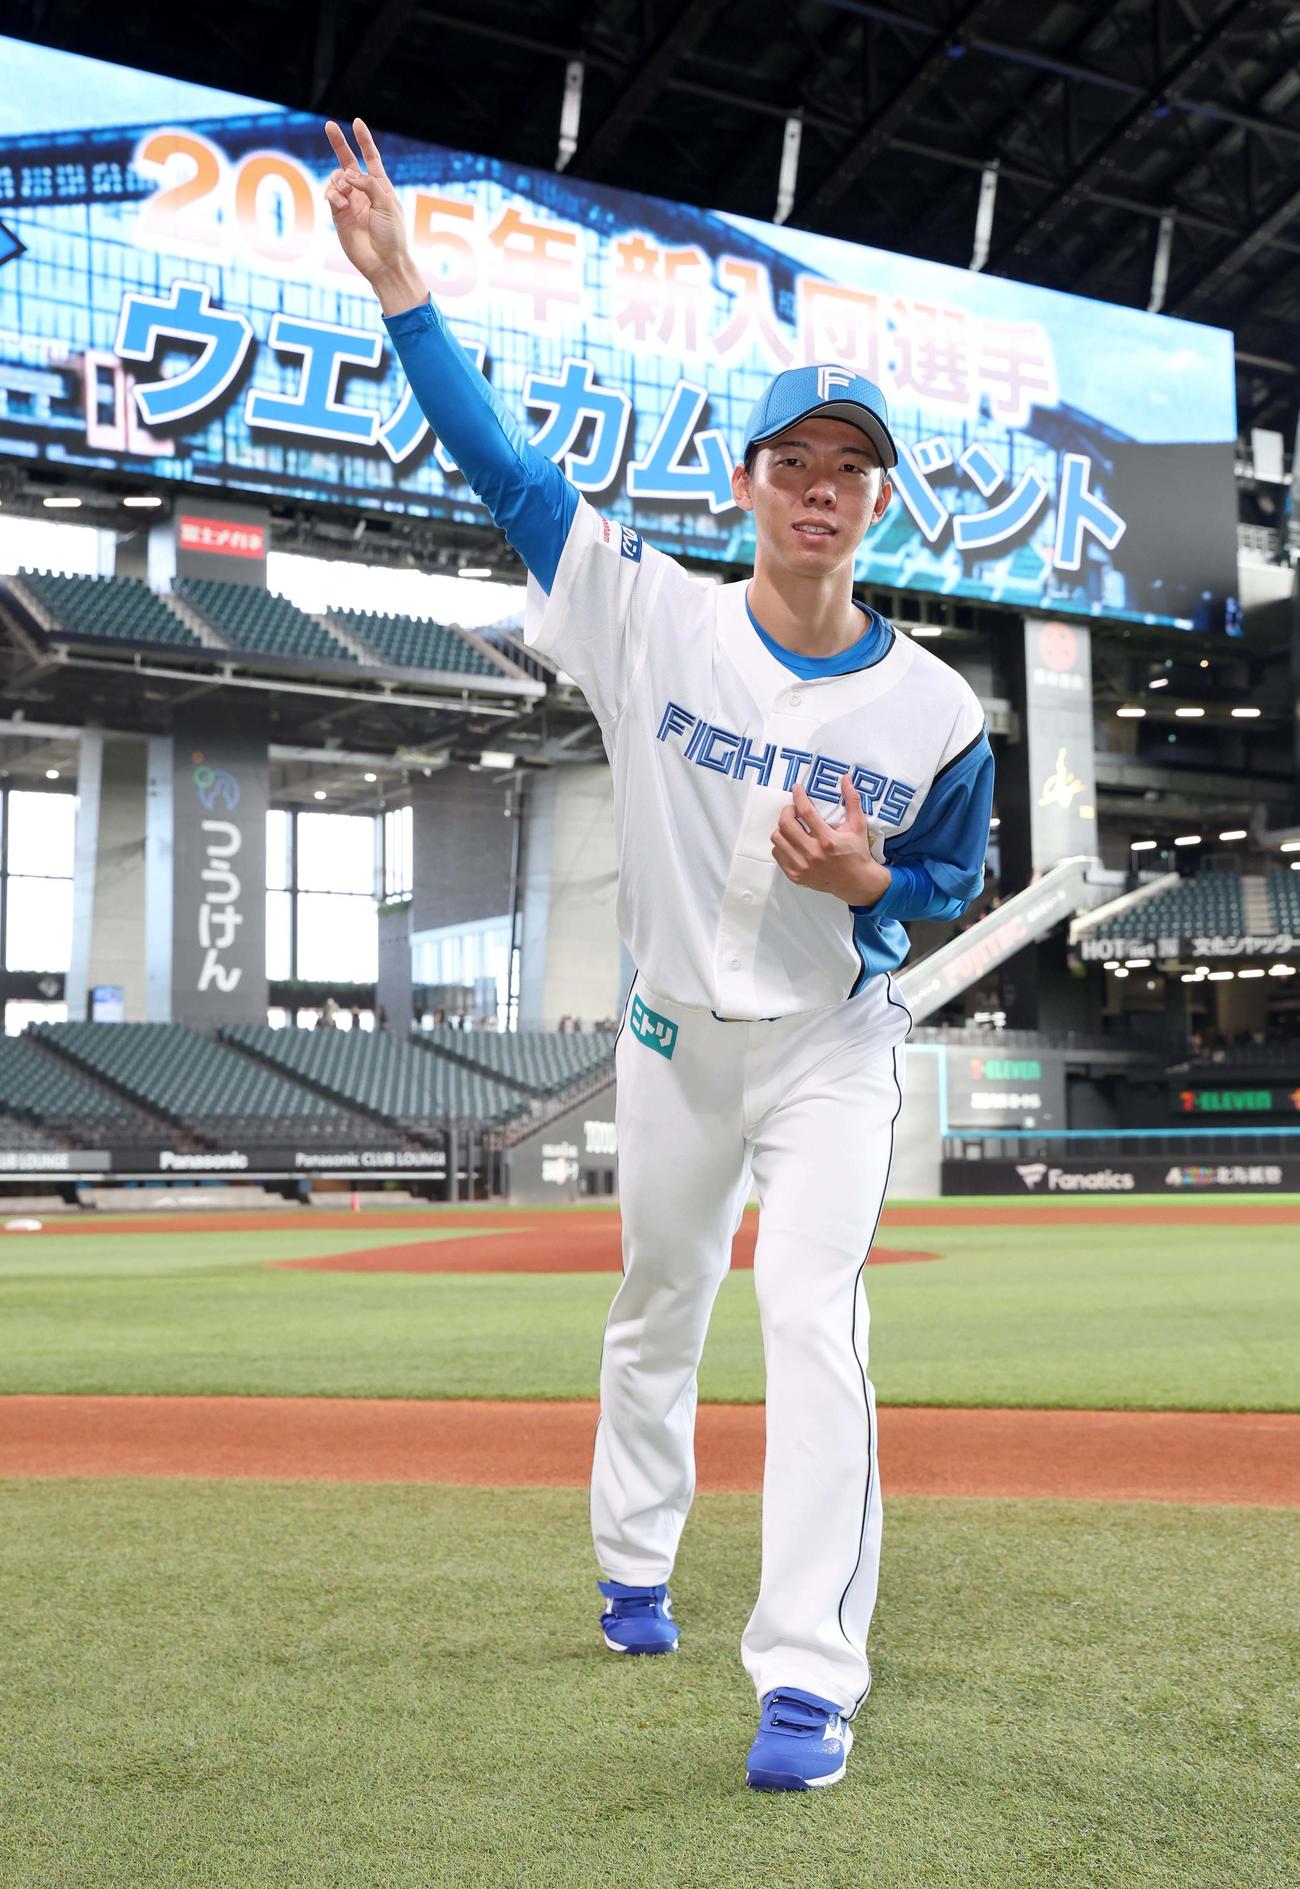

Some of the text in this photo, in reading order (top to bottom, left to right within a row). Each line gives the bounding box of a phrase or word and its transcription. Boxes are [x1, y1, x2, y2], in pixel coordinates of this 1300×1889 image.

[138, 132, 1050, 414] 205年 新入団選手
[817, 366, 857, 401] F
[656, 701, 917, 826] FIGHTERS
[198, 819, 243, 991] つうけん
[632, 1002, 673, 1048] ニトリ
[159, 1151, 248, 1170] Panasonic
[295, 1152, 360, 1167] Panasonic
[361, 1152, 396, 1167] CLUB
[1047, 1168, 1136, 1190] Fanatics
